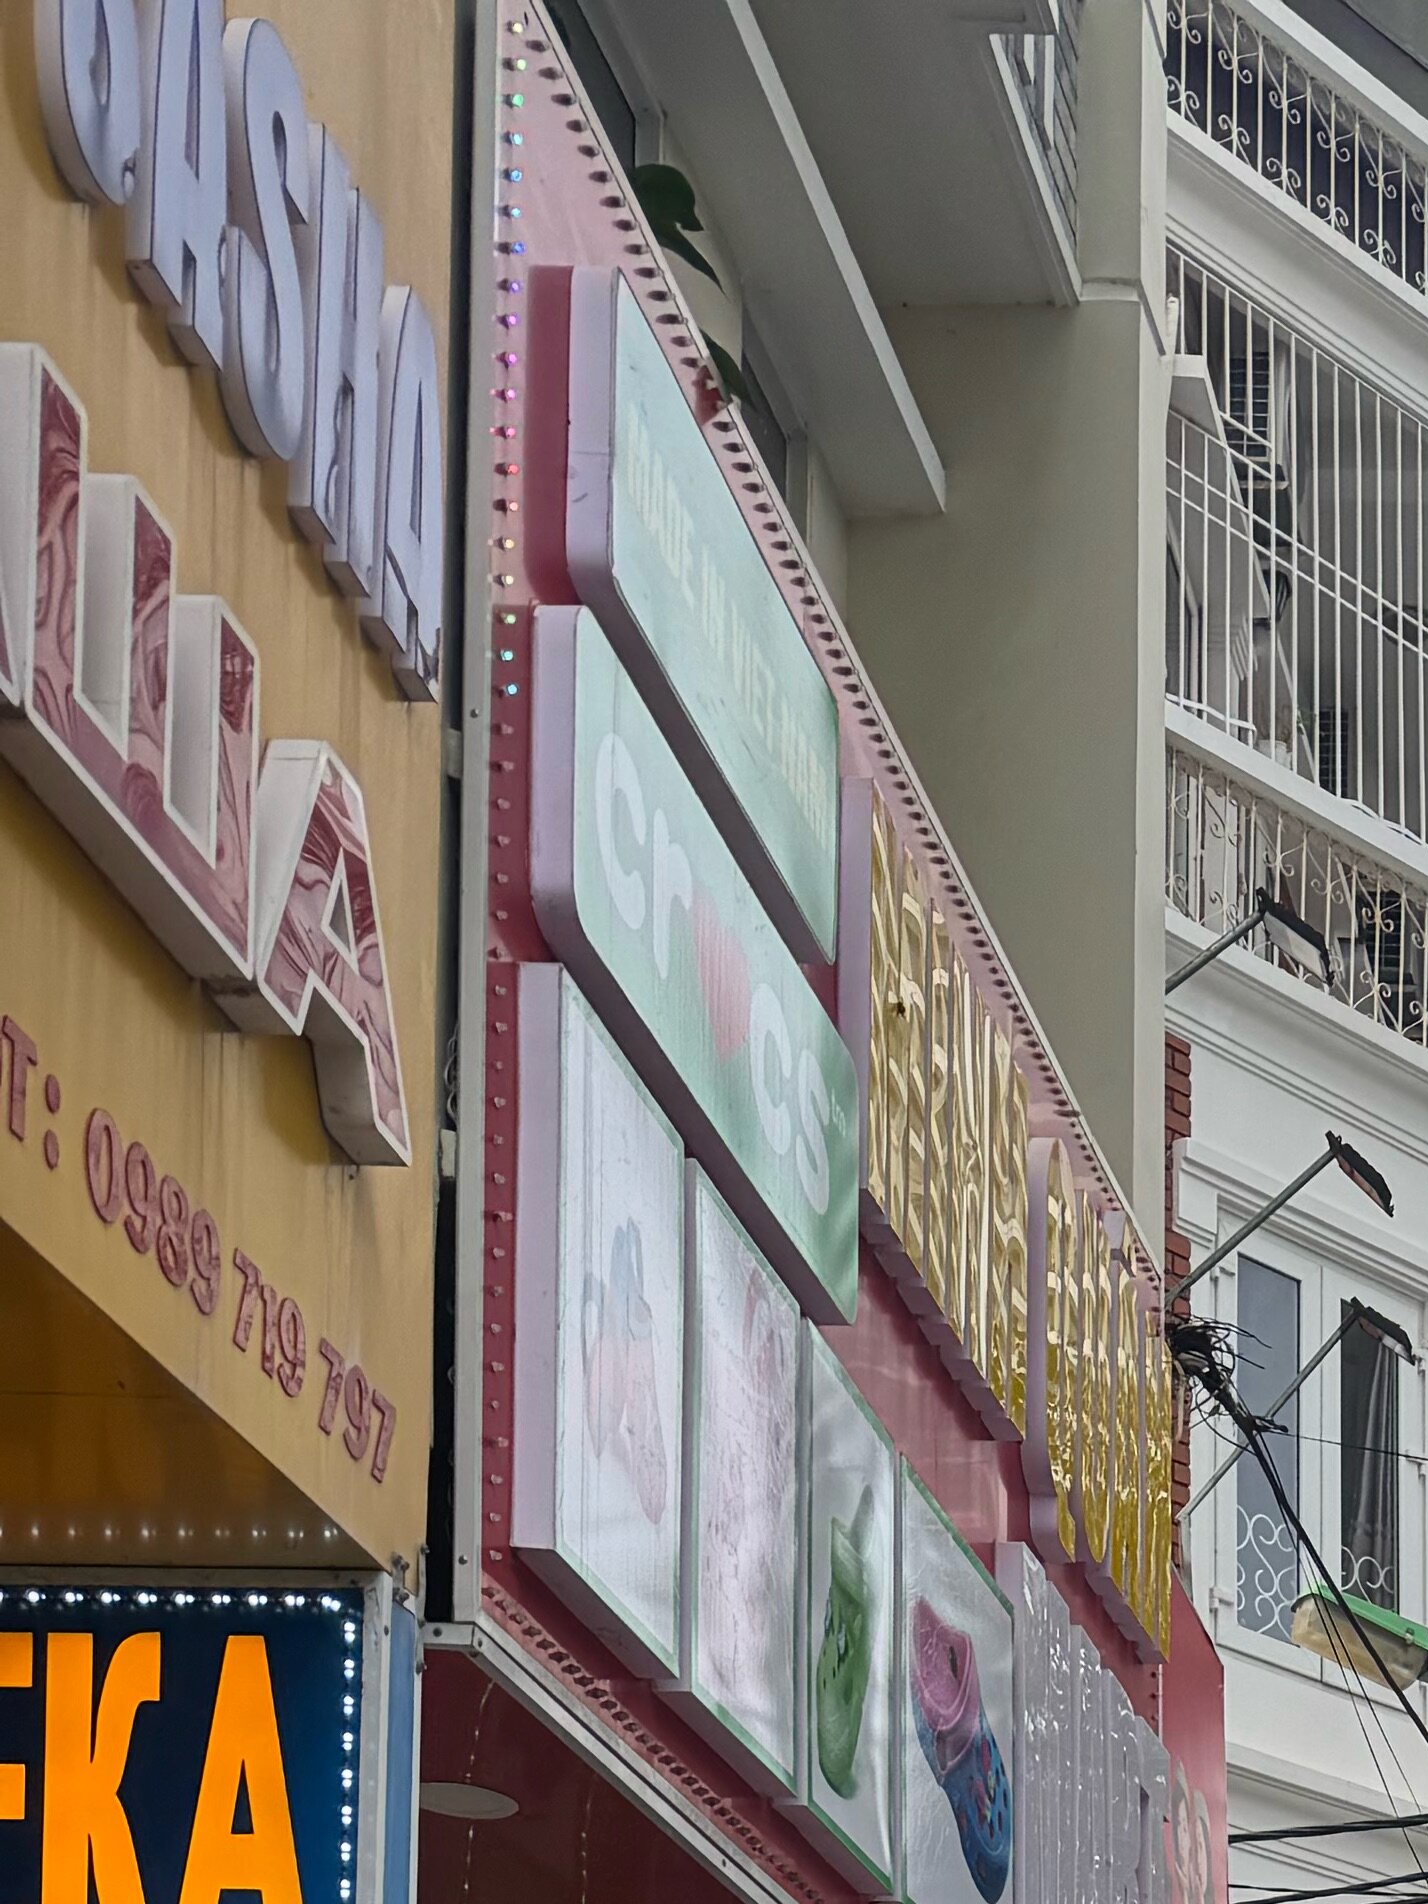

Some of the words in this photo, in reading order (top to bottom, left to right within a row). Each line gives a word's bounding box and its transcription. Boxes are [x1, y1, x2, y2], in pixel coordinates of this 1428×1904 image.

[598, 733, 829, 1215] crcs
[0, 1016, 60, 1170] T:
[84, 1108, 222, 1317] 0989
[232, 1248, 307, 1398] 719
[318, 1336, 397, 1483] 797
